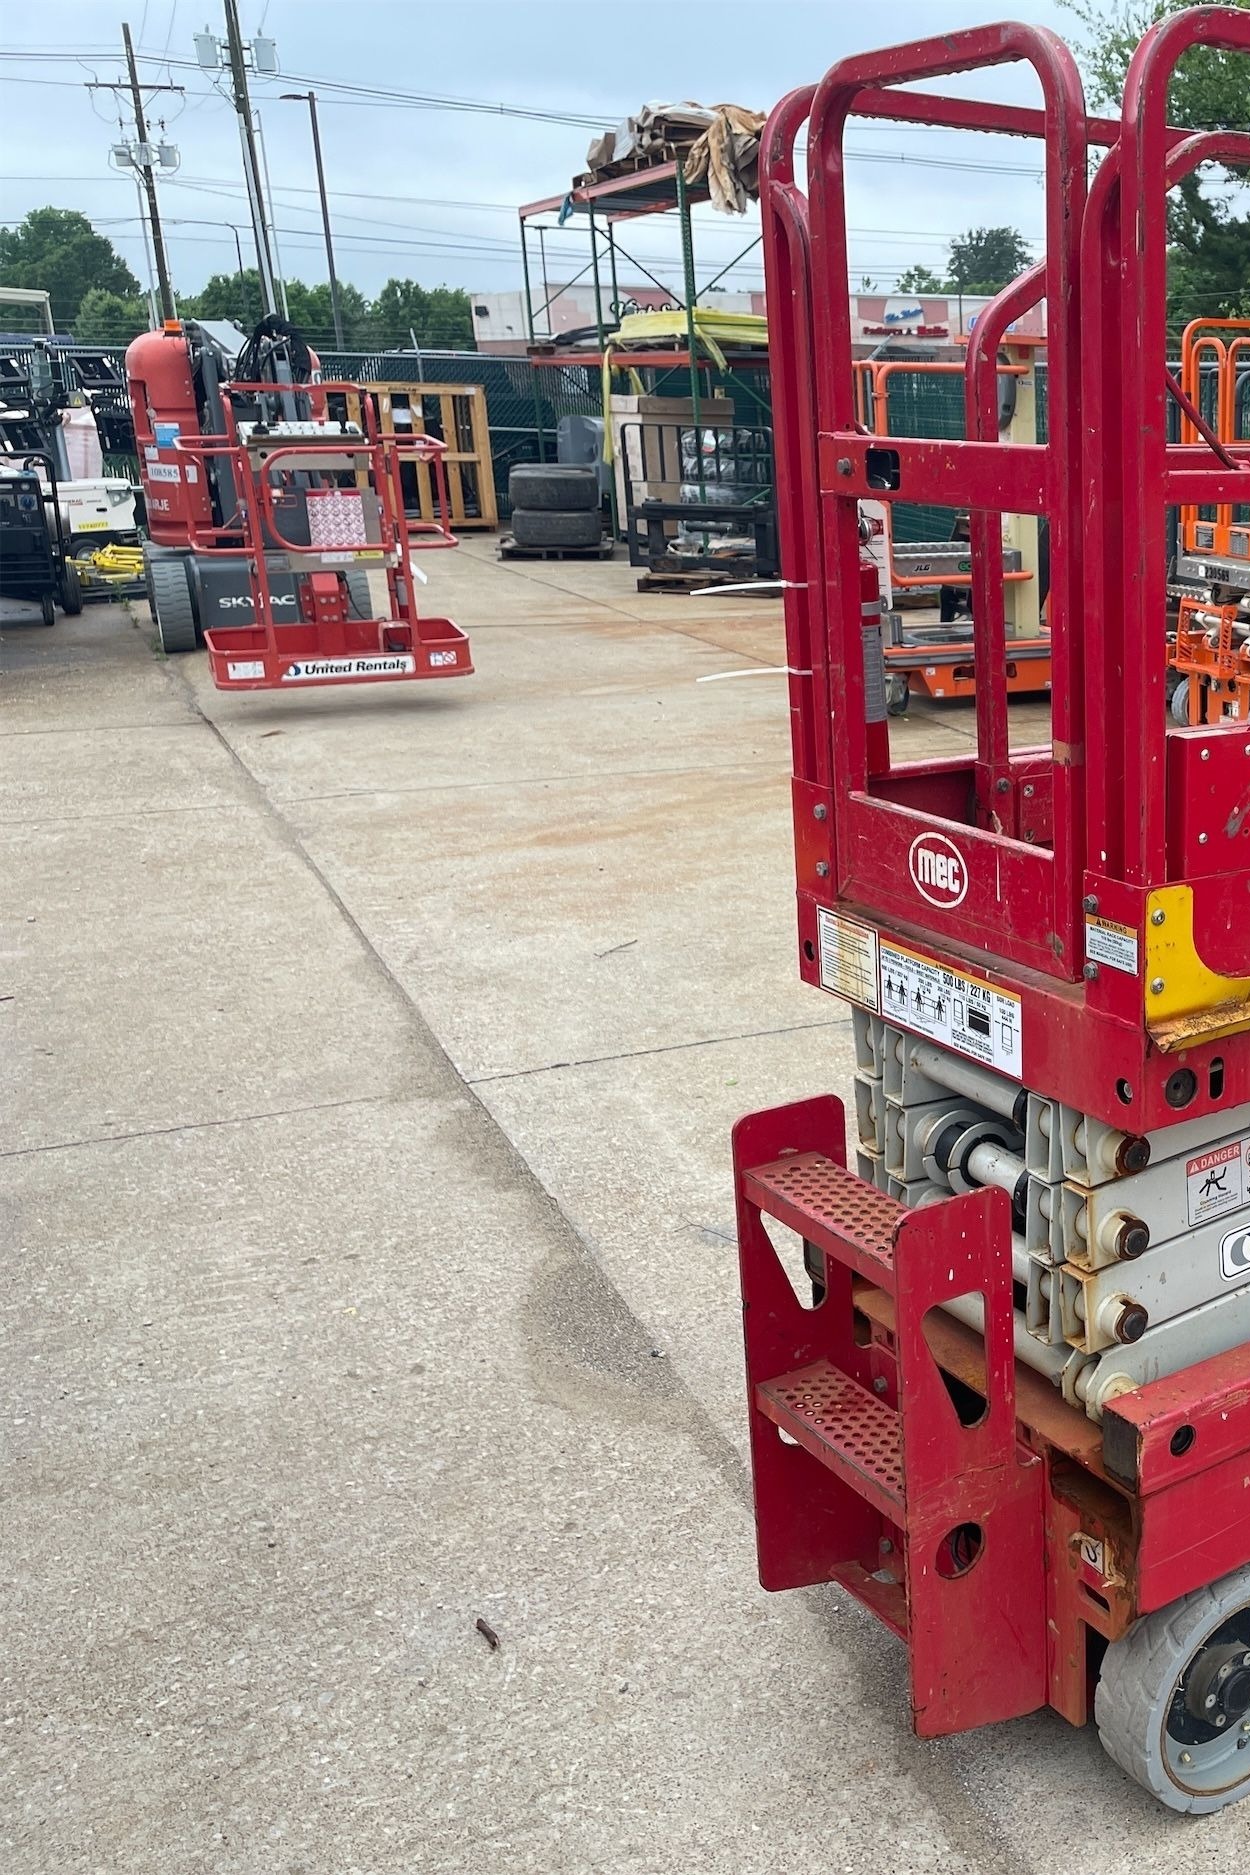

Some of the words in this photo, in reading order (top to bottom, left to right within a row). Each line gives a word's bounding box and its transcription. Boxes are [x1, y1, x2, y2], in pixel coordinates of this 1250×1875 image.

[914, 563, 930, 571] JLG
[305, 661, 352, 675] United
[356, 660, 407, 673] Rentals
[918, 848, 960, 894] mec
[900, 955, 921, 968] PLATFORM
[921, 962, 940, 976] CAPACITY
[943, 972, 954, 987] 500
[954, 976, 966, 992] LBS
[970, 983, 981, 999] 227
[982, 990, 991, 1003] KG
[1201, 1145, 1240, 1169] DANGER
